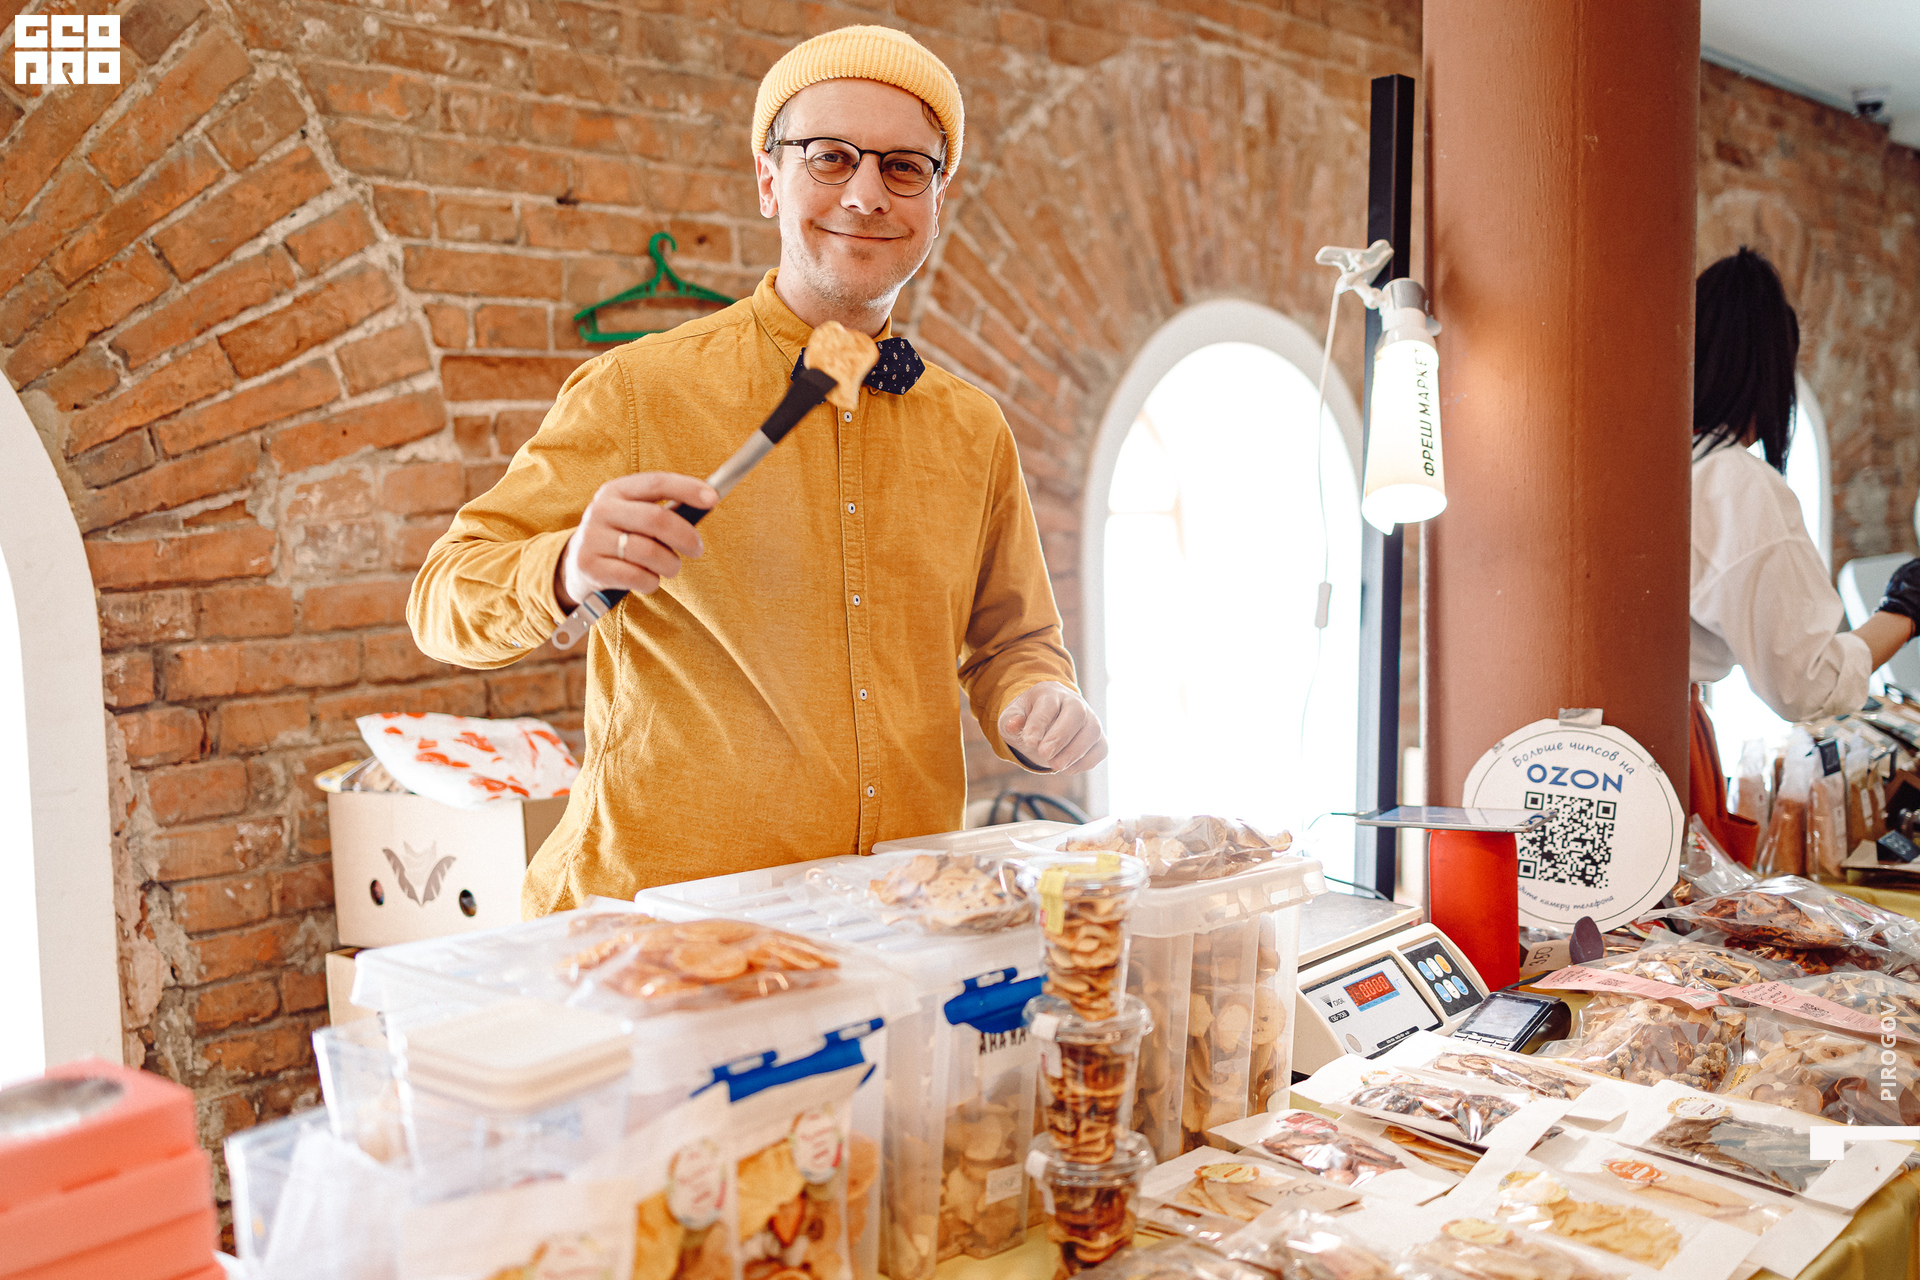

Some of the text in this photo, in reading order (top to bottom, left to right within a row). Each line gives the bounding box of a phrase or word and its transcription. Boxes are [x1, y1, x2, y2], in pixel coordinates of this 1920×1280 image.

[1512, 742, 1635, 775] Больше чипсов на
[1527, 763, 1623, 793] OZON
[1518, 884, 1614, 911] дите камеру телефона
[1529, 946, 1553, 966] 350
